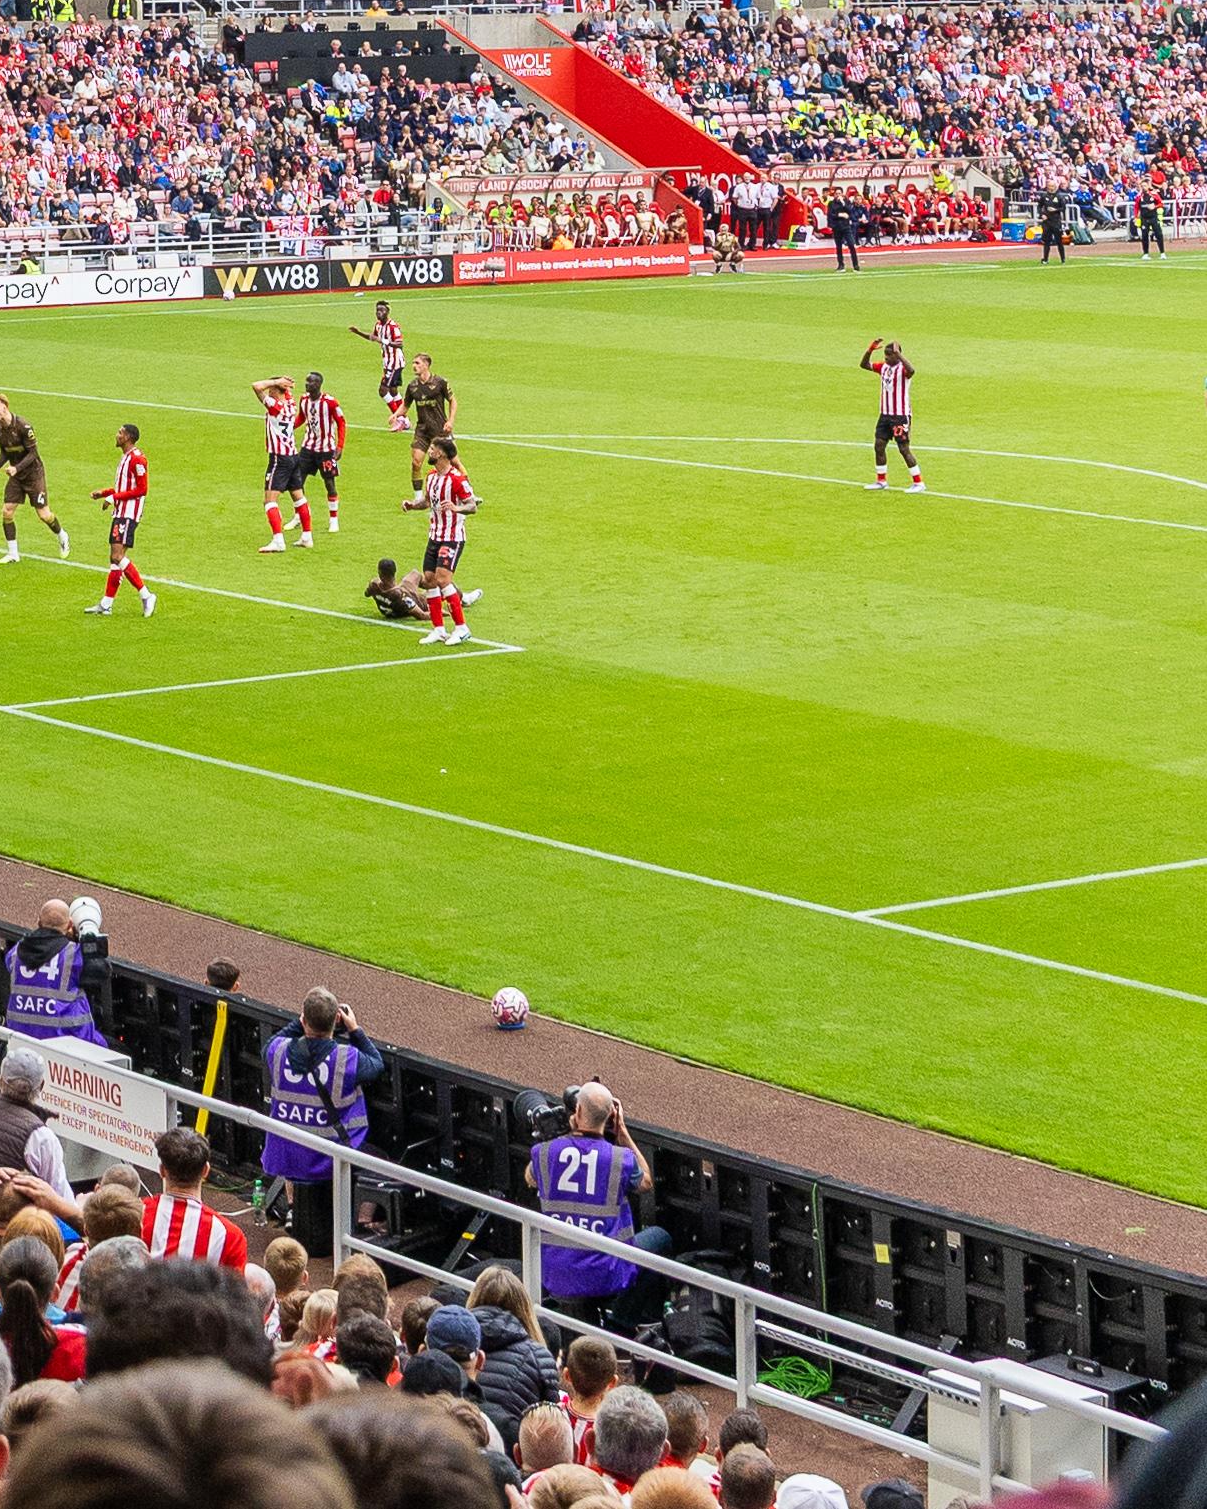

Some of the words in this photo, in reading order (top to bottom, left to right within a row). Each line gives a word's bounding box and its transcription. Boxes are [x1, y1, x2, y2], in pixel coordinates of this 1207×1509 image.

[389, 258, 443, 284] W88
[516, 260, 541, 271] Home
[542, 261, 551, 270] to
[552, 258, 613, 271] award-winning
[614, 257, 631, 268] Blue
[633, 256, 650, 268] Flag
[651, 255, 685, 266] beaches
[95, 273, 181, 297] Corpay
[264, 263, 320, 290] W88
[322, 459, 332, 471] 19
[16, 995, 57, 1015] SAFC
[48, 1060, 122, 1107] WARNING
[41, 1091, 73, 1112] OFFENCE
[73, 1101, 87, 1116] FOR
[88, 1108, 133, 1133] SPECTATORS
[132, 1123, 143, 1137] TO
[278, 1102, 328, 1125] SAFC
[62, 1114, 89, 1133] EXCEPT
[88, 1125, 96, 1135] IN
[97, 1126, 109, 1140] AN
[109, 1132, 154, 1157] EMERGENCY
[557, 1146, 599, 1196] 21
